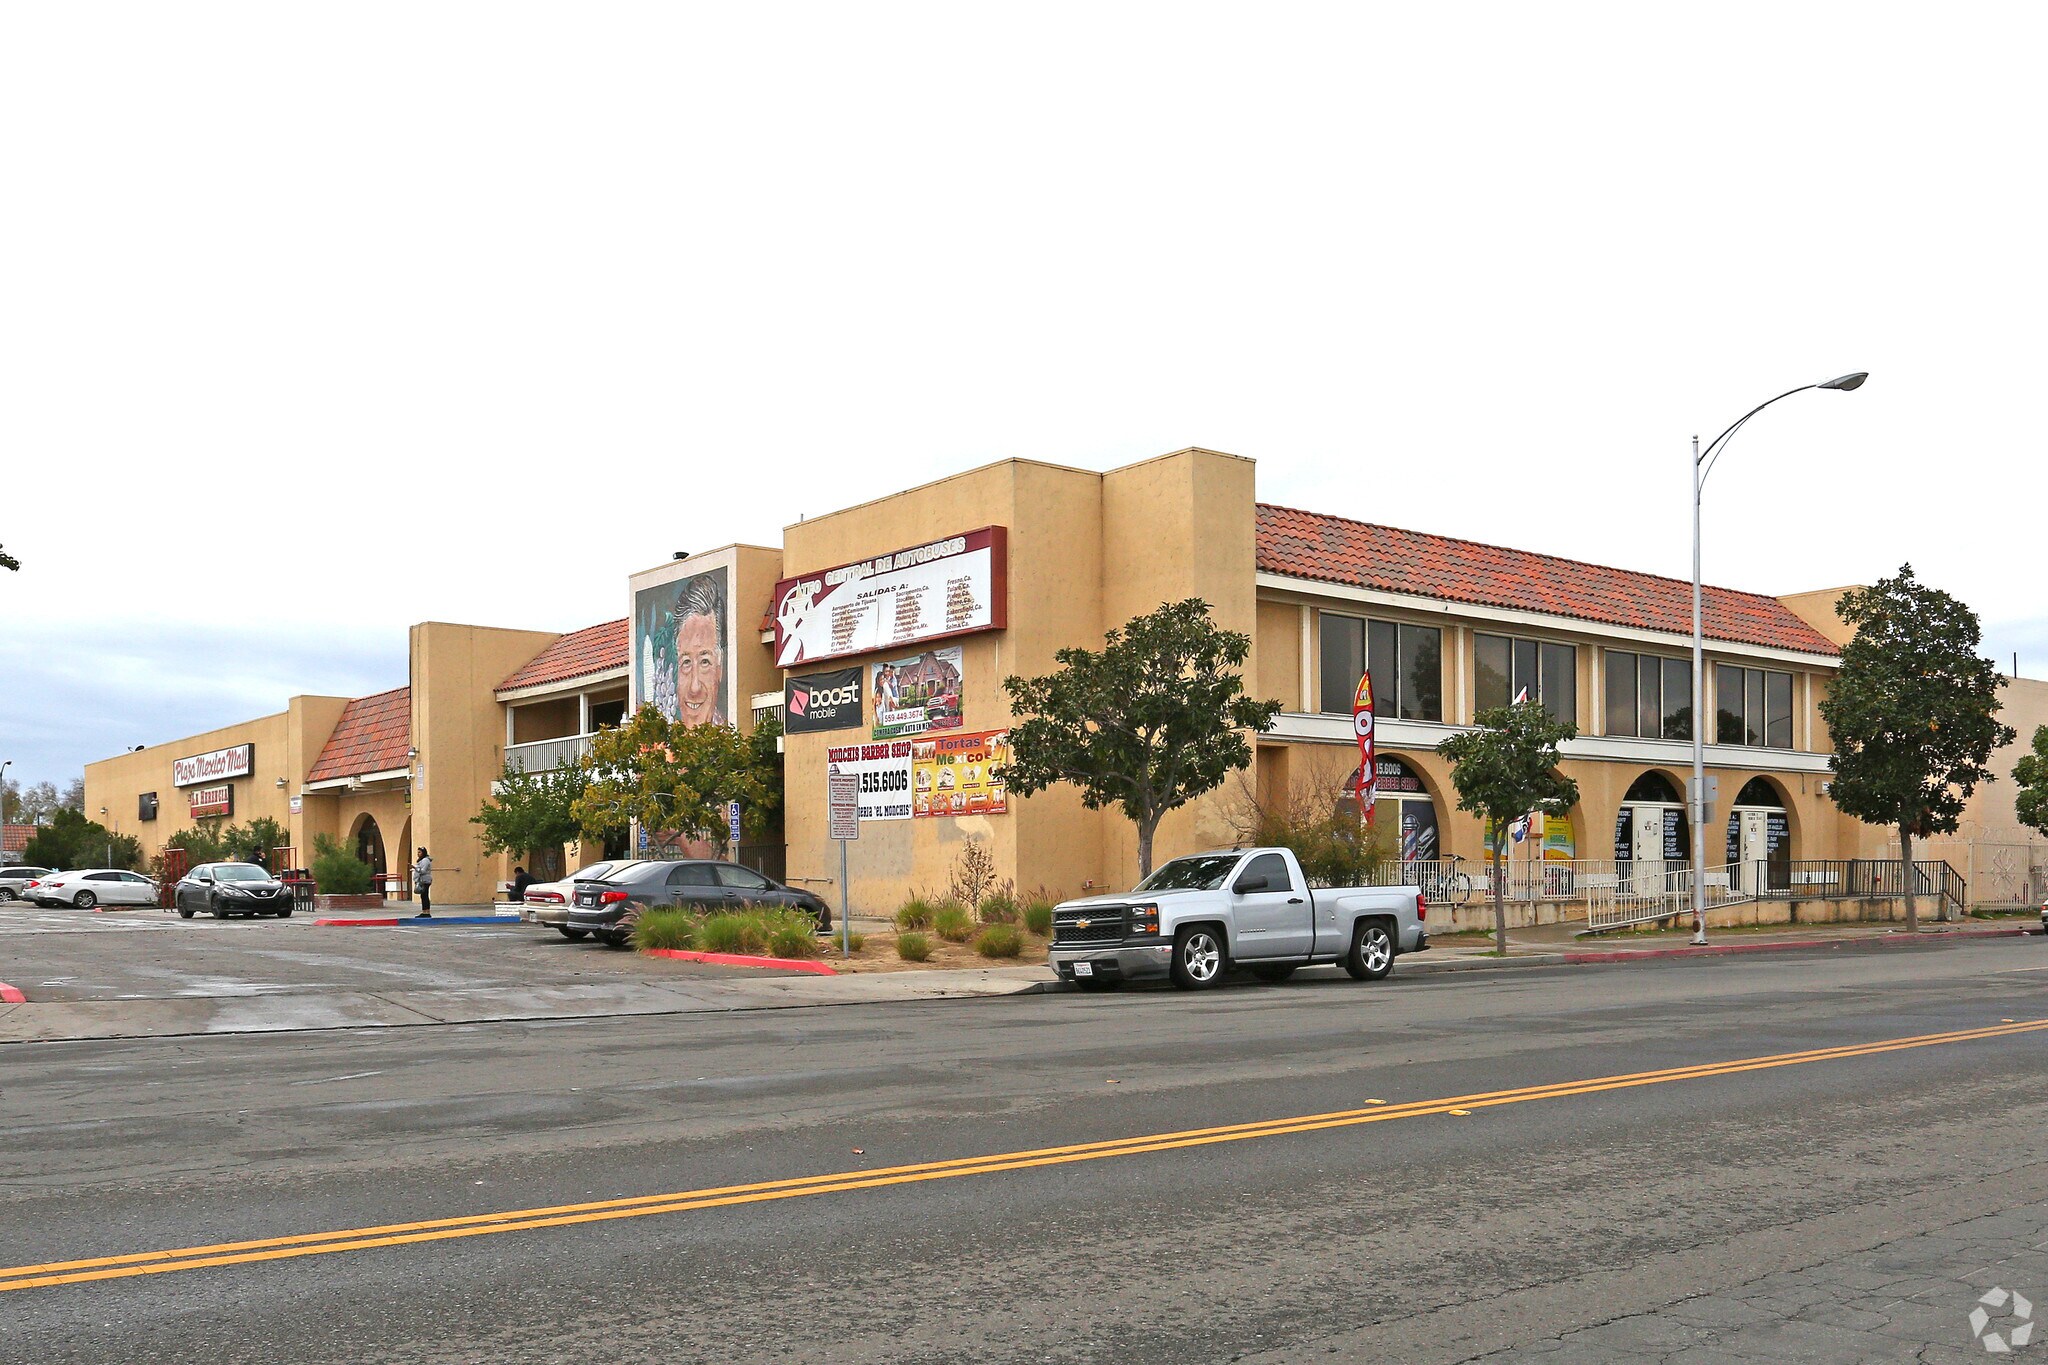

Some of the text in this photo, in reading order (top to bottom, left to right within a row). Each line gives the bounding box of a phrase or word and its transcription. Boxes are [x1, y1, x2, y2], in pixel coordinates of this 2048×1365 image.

[825, 562, 874, 586] CENTRAL
[875, 556, 893, 575] DE
[893, 537, 966, 570] AUTOBUSES
[857, 583, 909, 600] SALIDAS A:
[810, 681, 859, 708] boost
[810, 707, 837, 719] mobile
[892, 741, 912, 758] SHOP
[938, 738, 980, 750] Tortas
[175, 746, 249, 784] Plaza Mexico Mall
[936, 752, 983, 766] México
[1376, 762, 1401, 775] 15.6006
[858, 769, 908, 793] .515.6006
[191, 791, 199, 806] LA
[200, 788, 228, 805] HERENCIA
